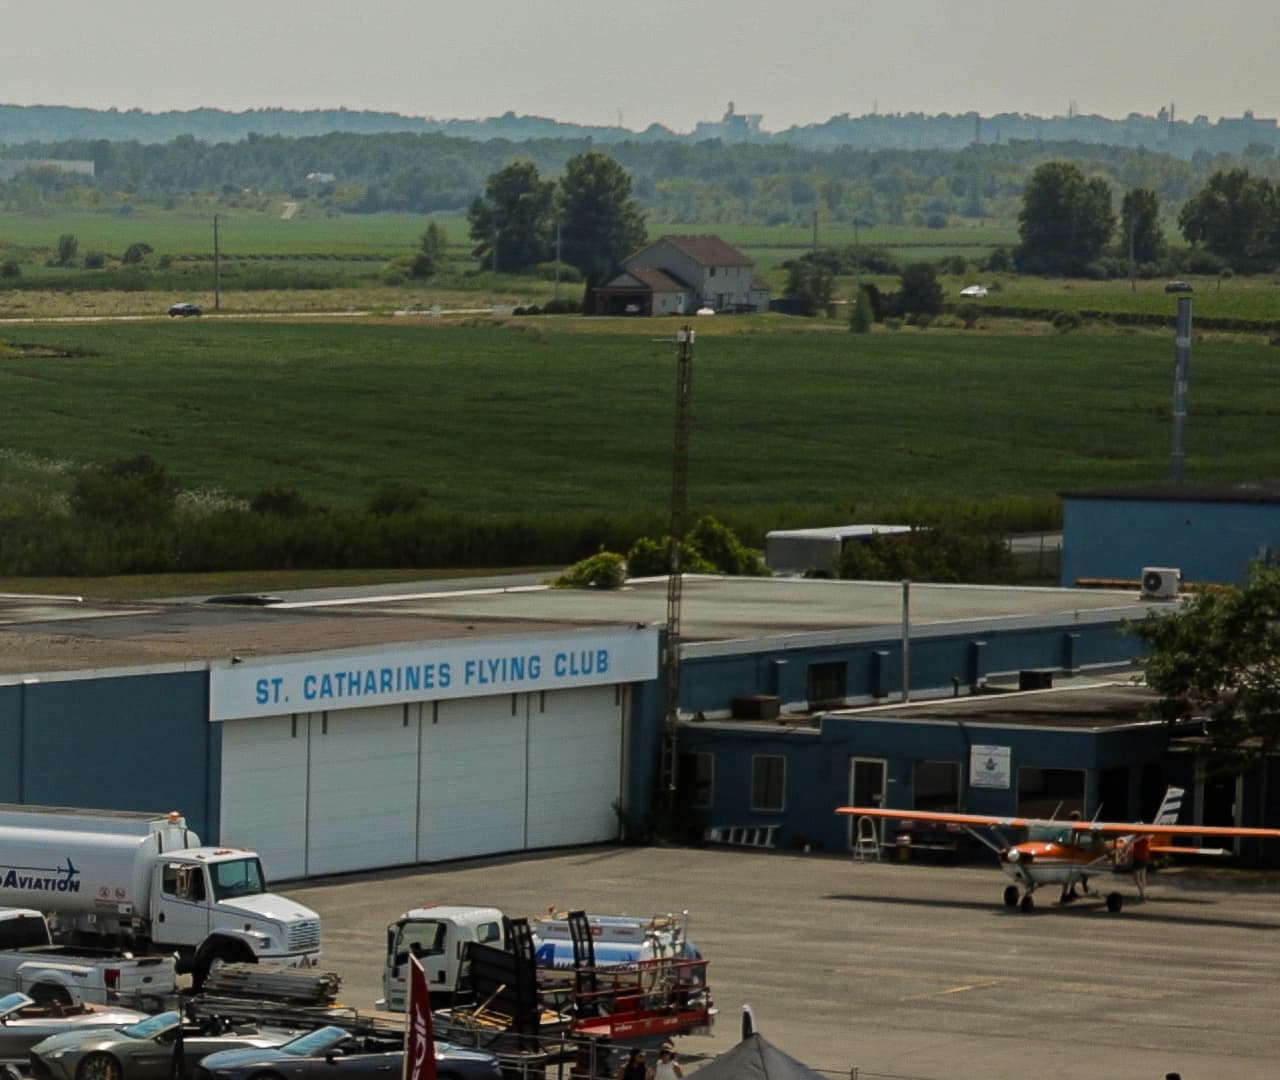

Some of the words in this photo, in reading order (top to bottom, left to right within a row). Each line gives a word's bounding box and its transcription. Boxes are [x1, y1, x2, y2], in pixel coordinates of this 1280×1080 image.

[255, 678, 289, 704] ST.
[303, 662, 452, 701] CATHARINES
[464, 656, 542, 685] FLYING
[553, 649, 610, 677] CLUB
